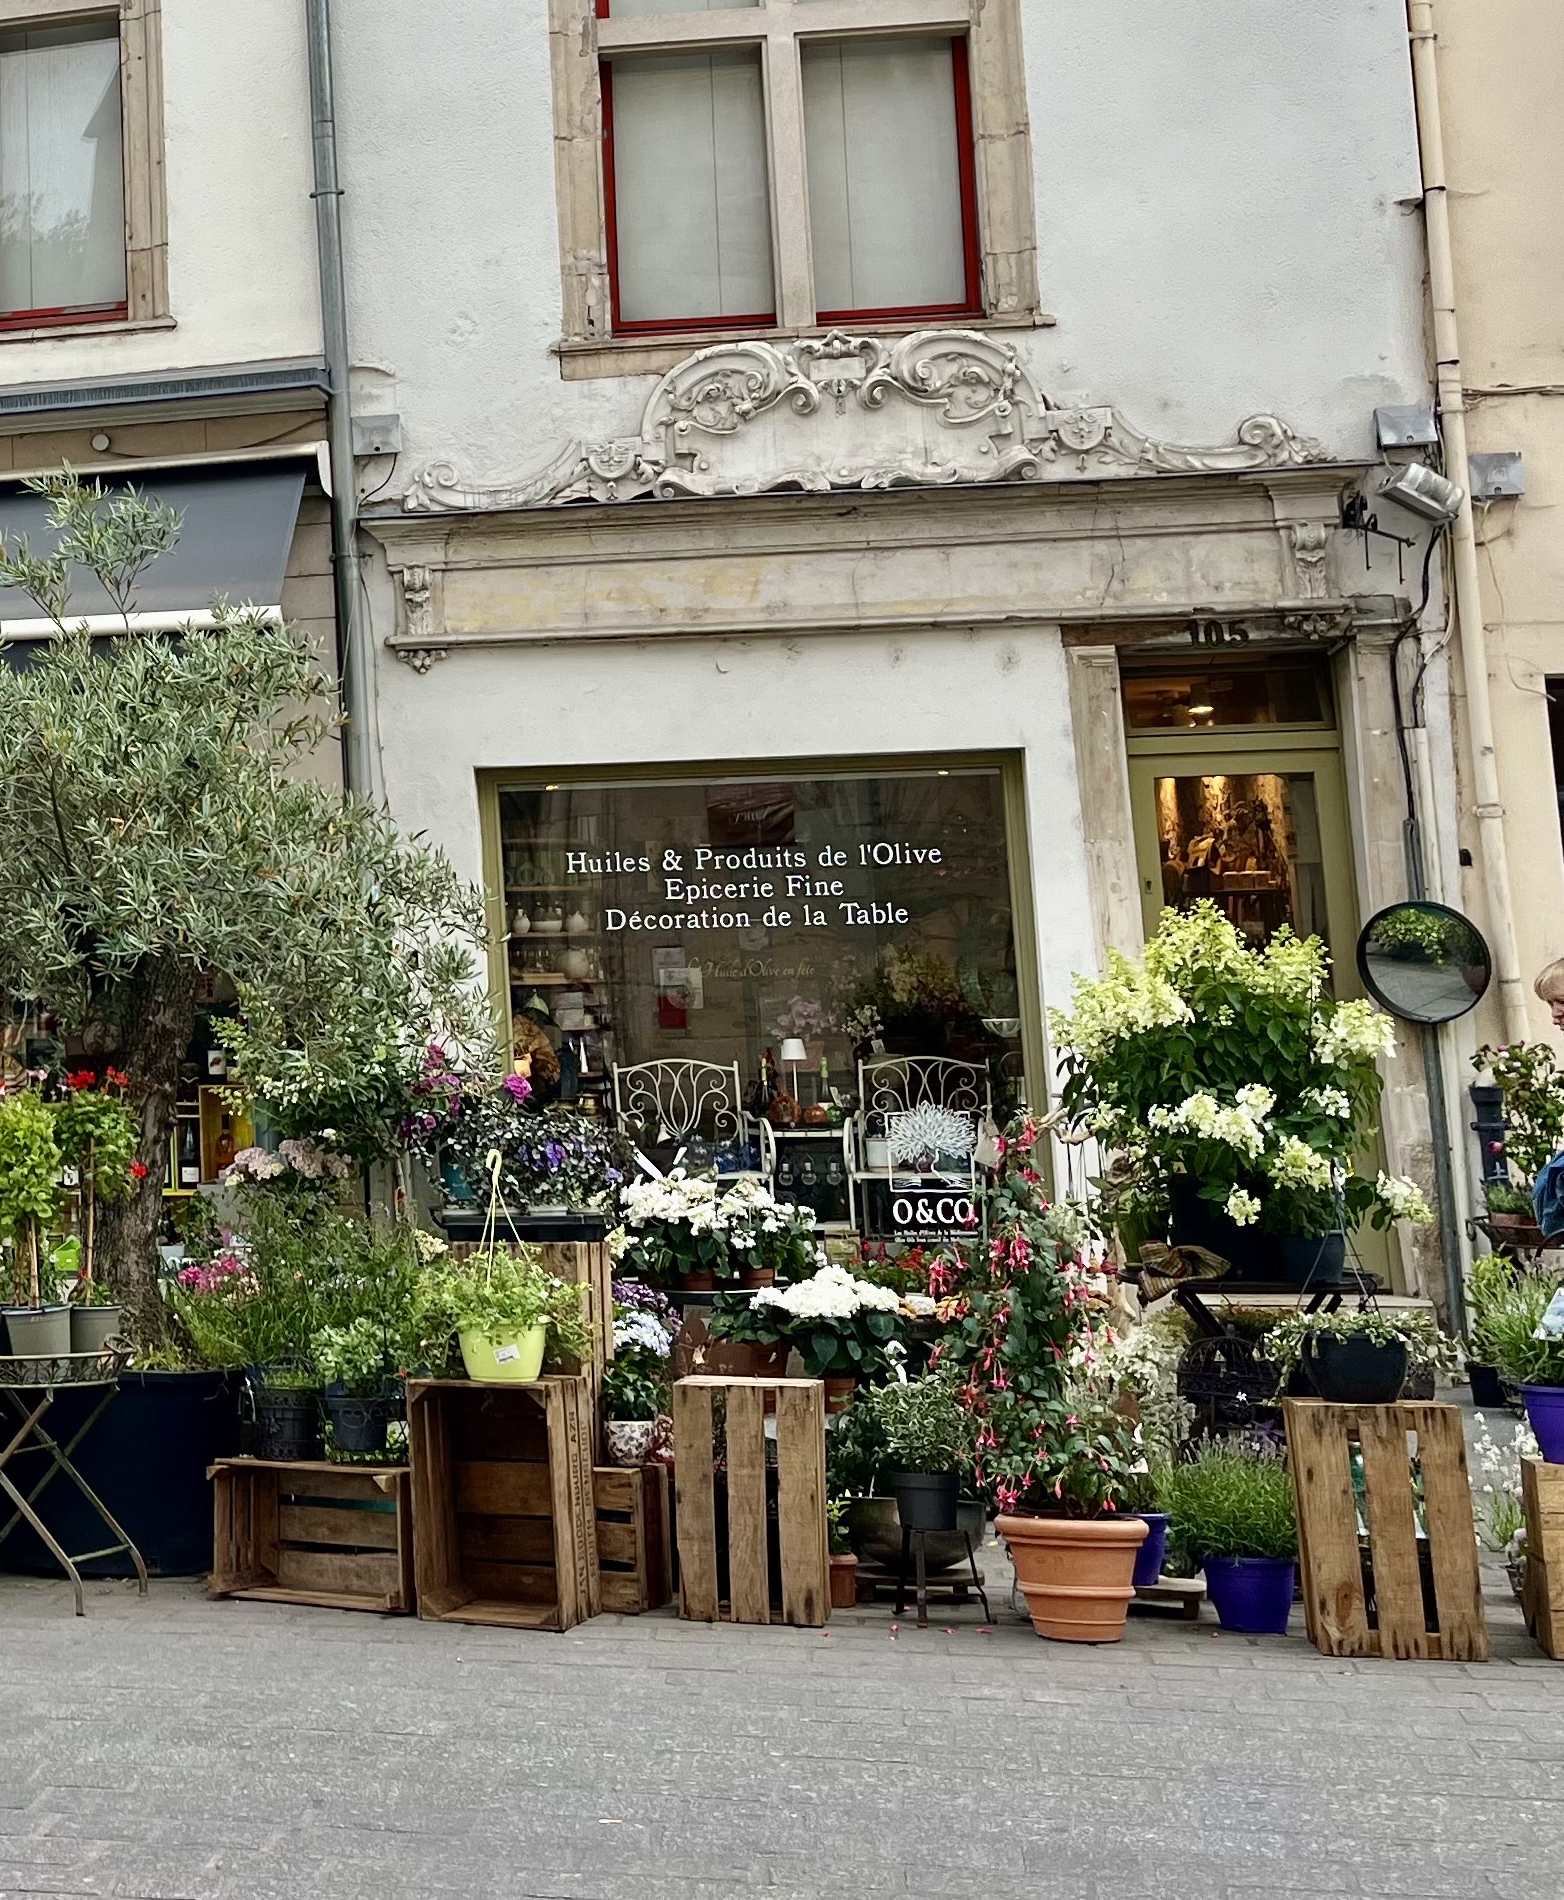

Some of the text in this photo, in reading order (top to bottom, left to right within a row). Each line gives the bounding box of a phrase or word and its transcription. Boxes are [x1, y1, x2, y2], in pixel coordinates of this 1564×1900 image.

[1190, 619, 1250, 648] 105
[565, 842, 942, 874] Huiles & Produits de l'Olive
[664, 874, 844, 905] Epicerie Fine
[605, 901, 909, 931] Décoration de la Table
